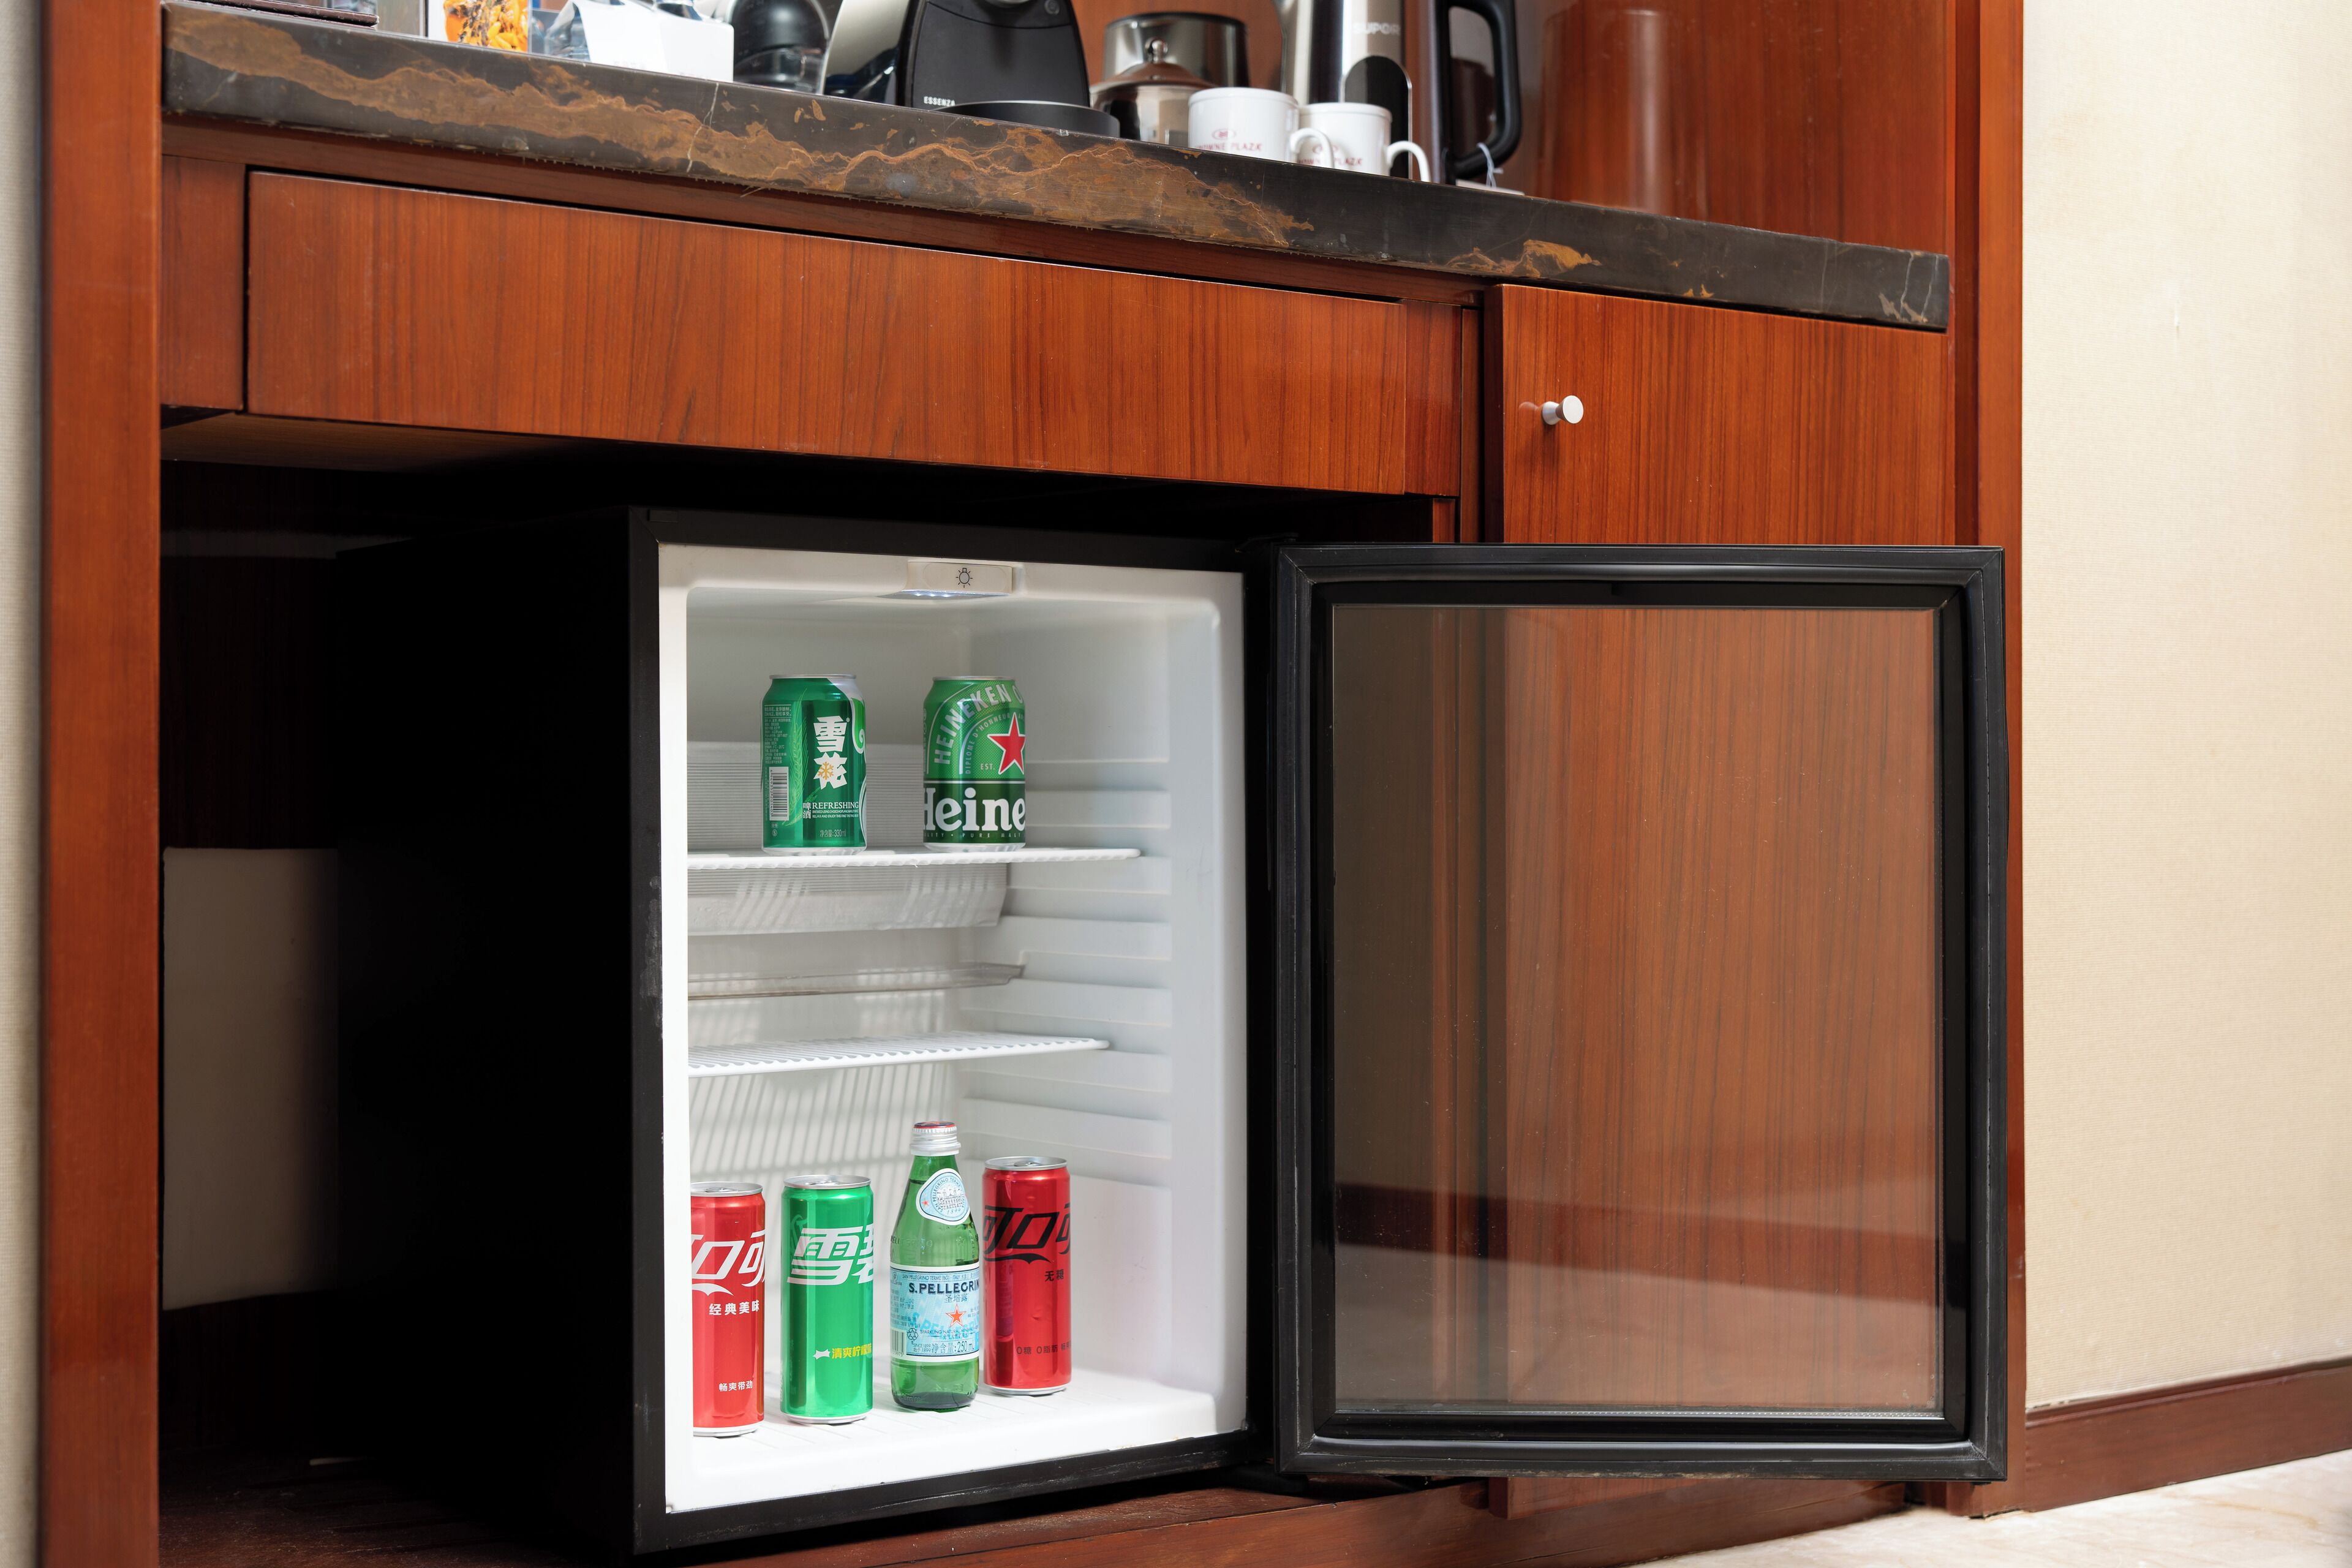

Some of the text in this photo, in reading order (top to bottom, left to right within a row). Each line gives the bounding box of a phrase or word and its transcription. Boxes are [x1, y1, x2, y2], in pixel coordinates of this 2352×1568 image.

[924, 96, 956, 107] ESSENZA
[934, 684, 1012, 764] HEINEKEN
[813, 715, 848, 790] 雪花
[965, 740, 975, 775] DIPLOME
[802, 802, 812, 820] 啤酒
[1044, 1268, 1065, 1282] 无糖
[709, 1300, 760, 1316] 经典美味
[718, 1380, 753, 1392] 畅爽带劲
